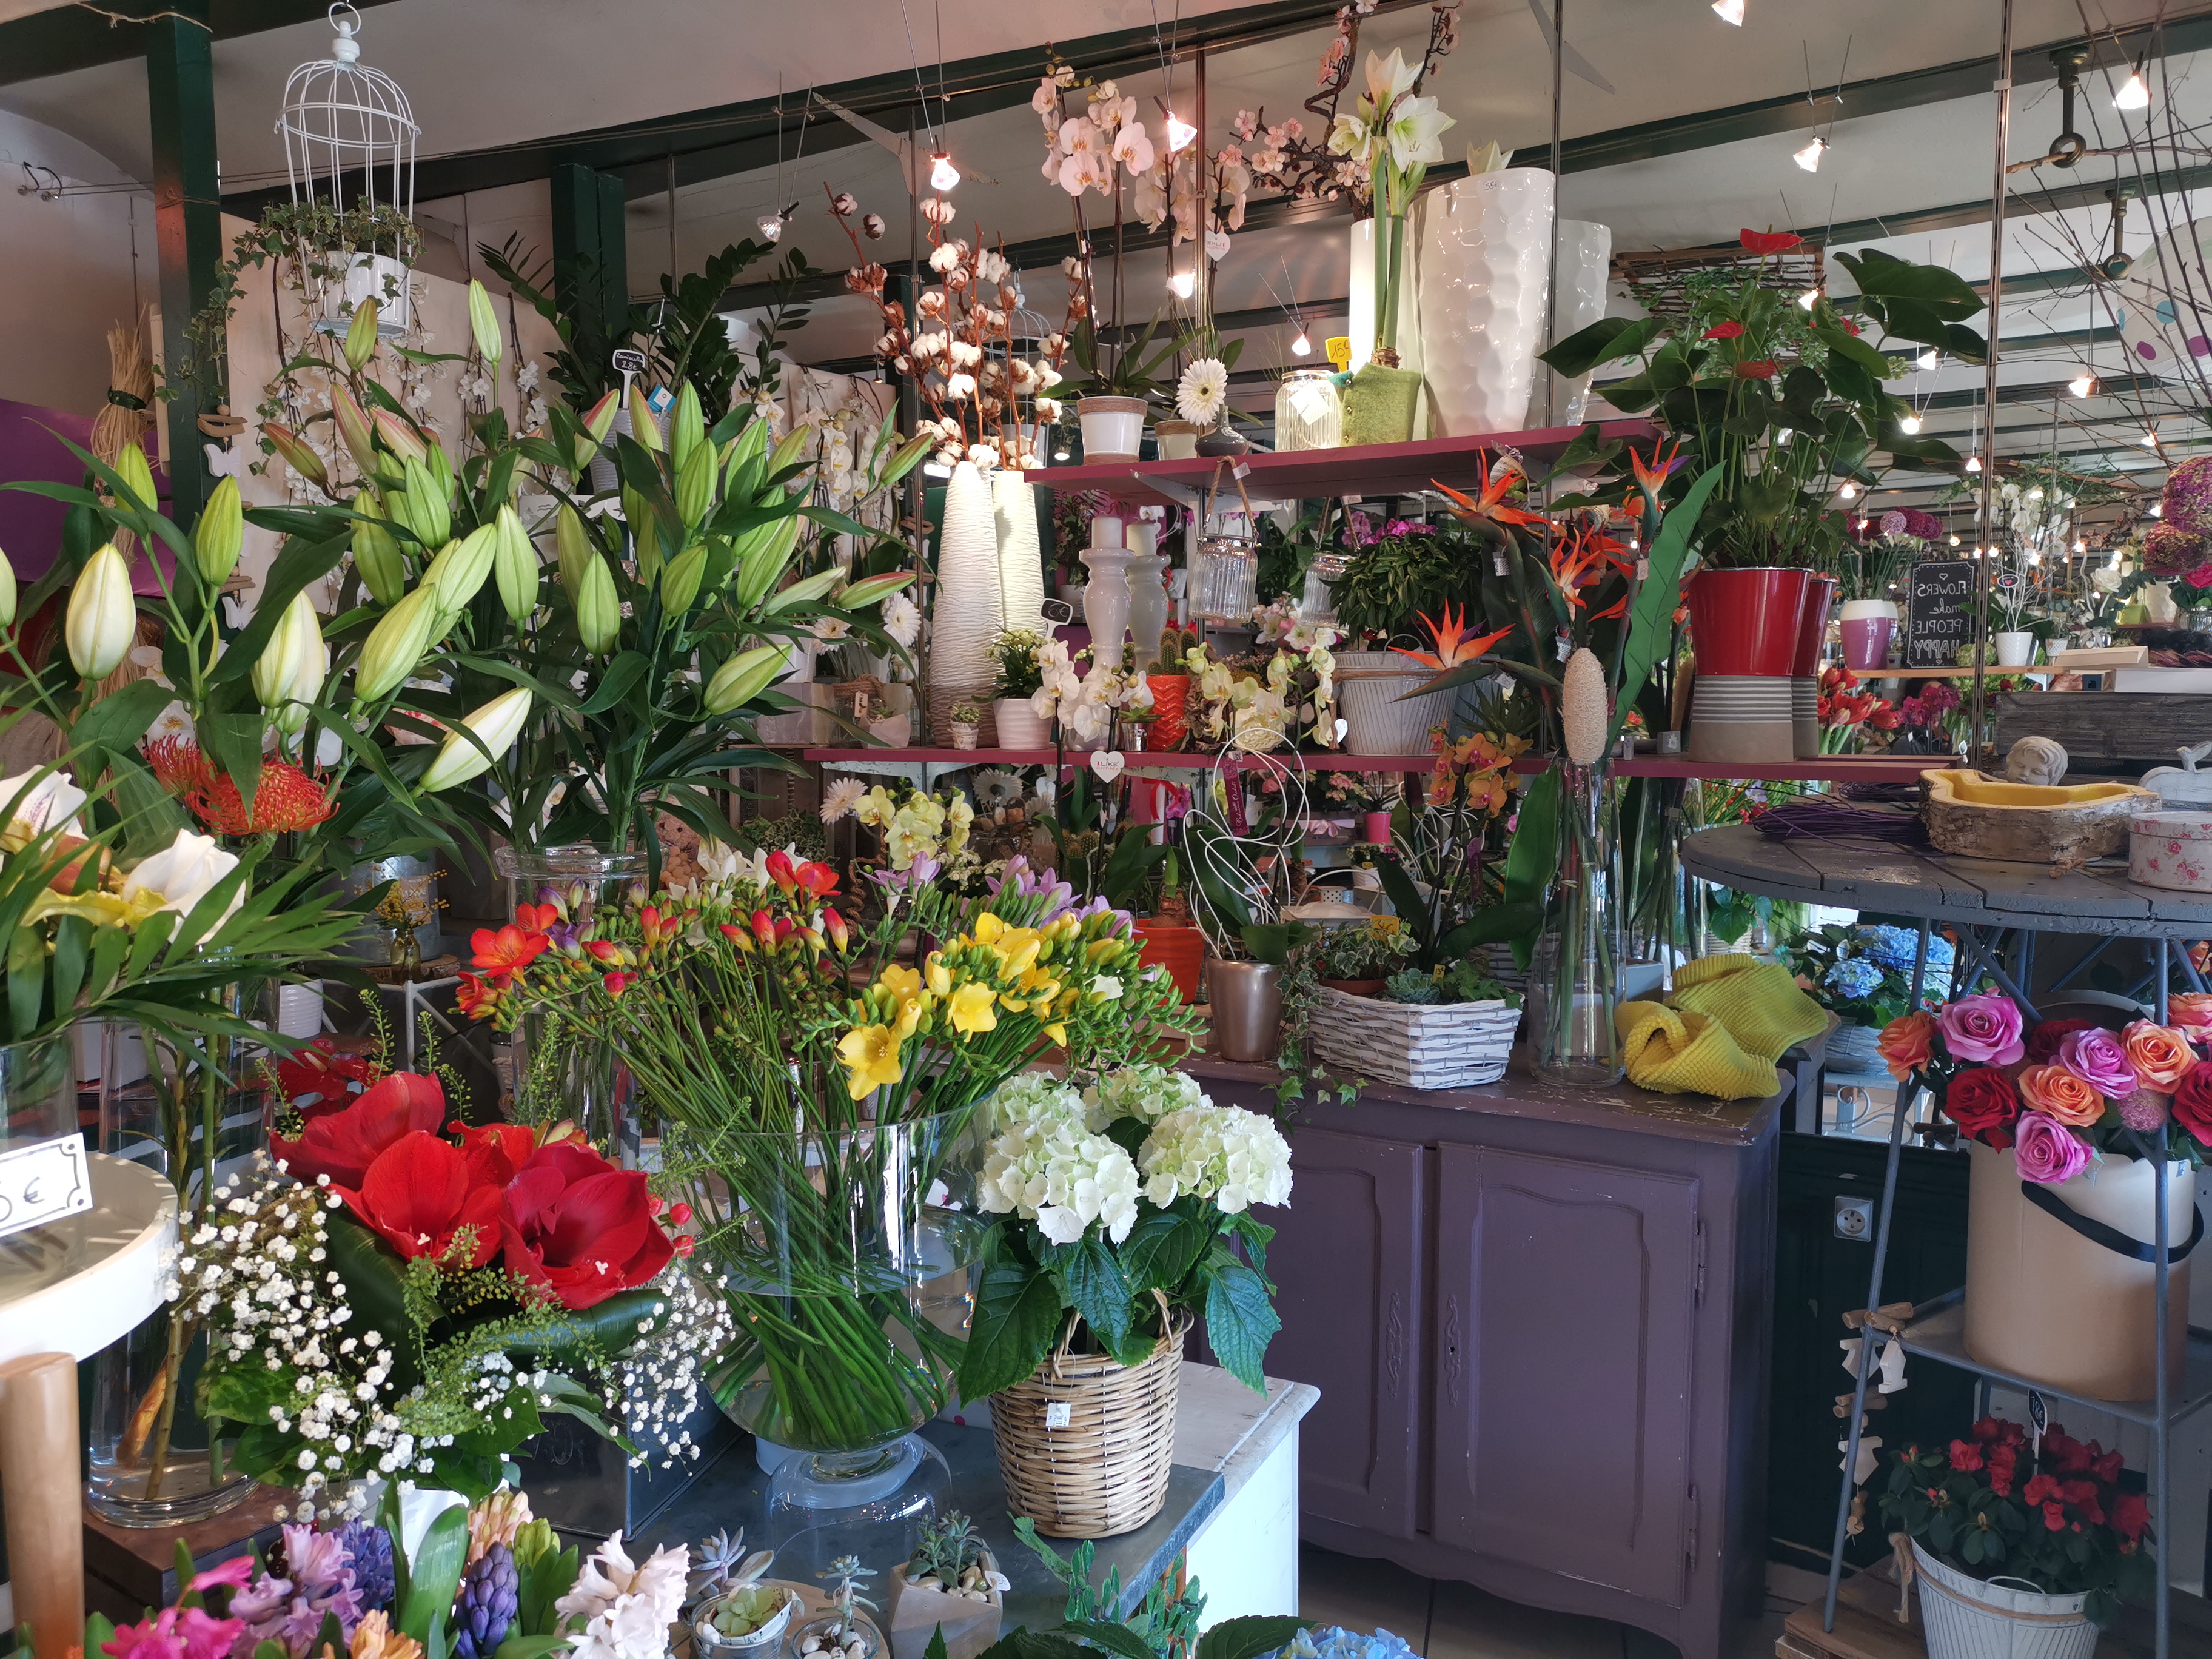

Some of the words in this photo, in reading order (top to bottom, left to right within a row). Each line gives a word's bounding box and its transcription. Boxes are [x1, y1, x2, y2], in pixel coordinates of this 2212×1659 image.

[1485, 181, 1498, 191] 55€
[621, 360, 638, 370] 28€
[1047, 603, 1068, 617] 6€
[2030, 1396, 2043, 1425] 18€
